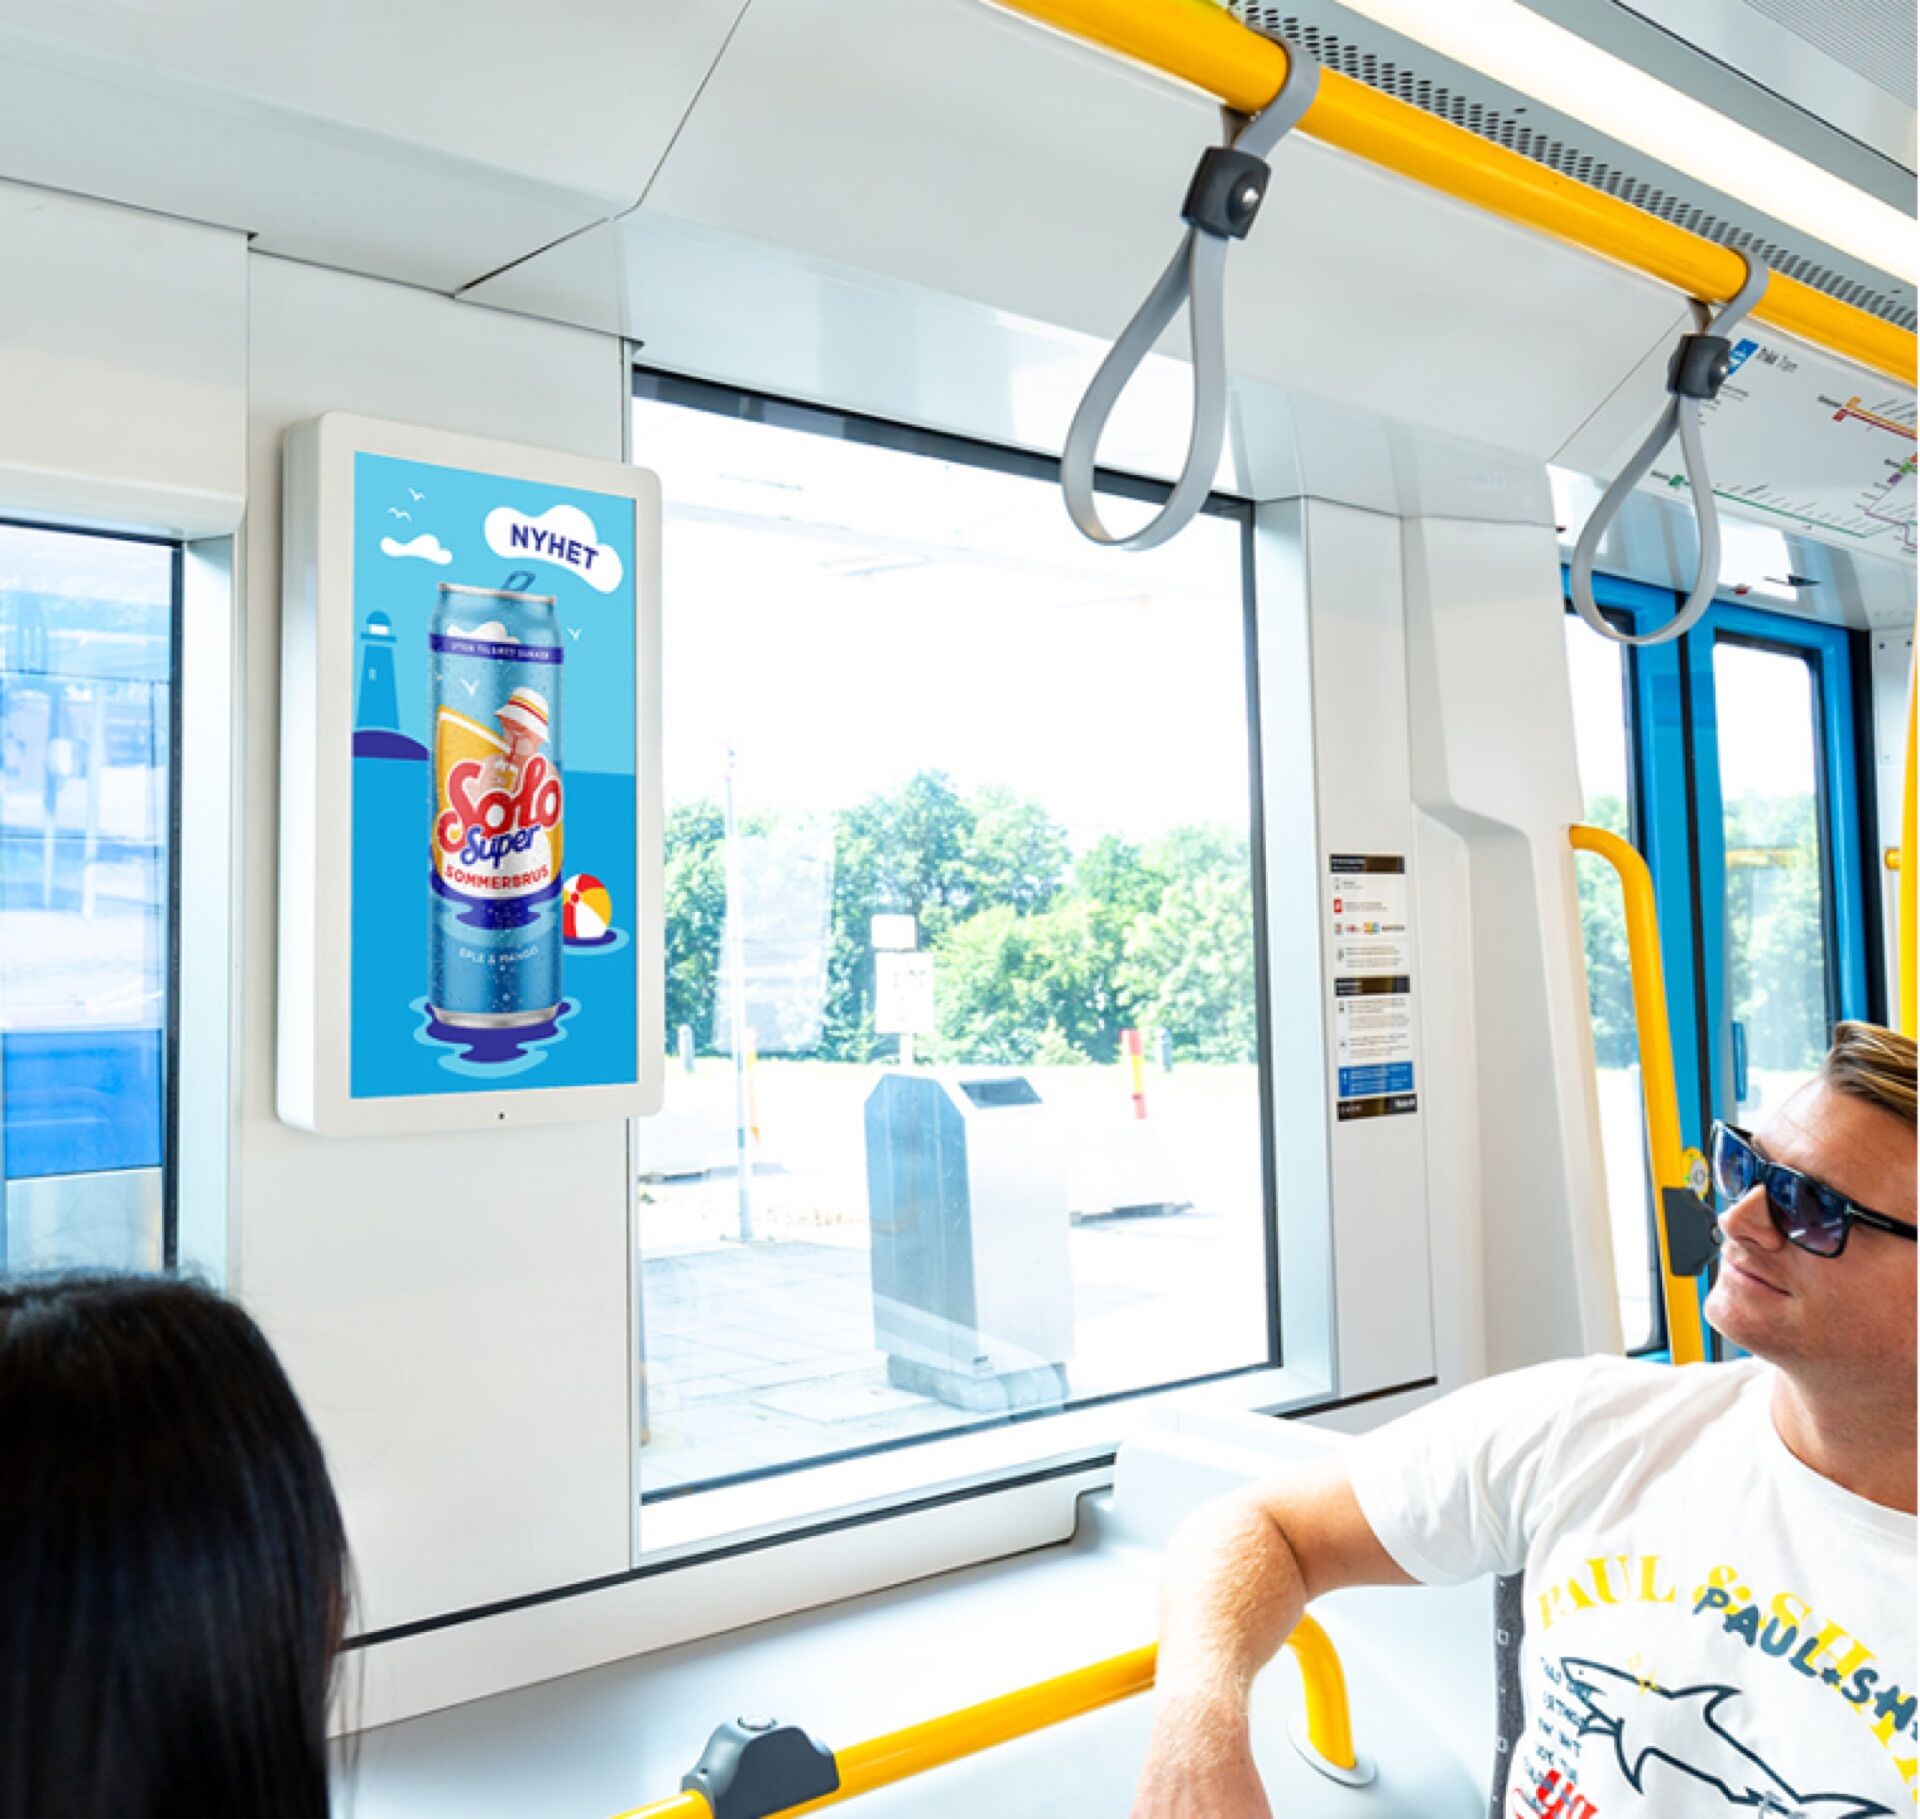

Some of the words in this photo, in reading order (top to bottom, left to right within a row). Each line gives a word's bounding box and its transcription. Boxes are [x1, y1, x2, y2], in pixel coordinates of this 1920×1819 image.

[510, 523, 599, 570] NYHET
[437, 756, 562, 853] Solo
[460, 825, 541, 868] Super
[445, 863, 549, 890] SOMMERBRUS
[1538, 1555, 1676, 1631] PAUL
